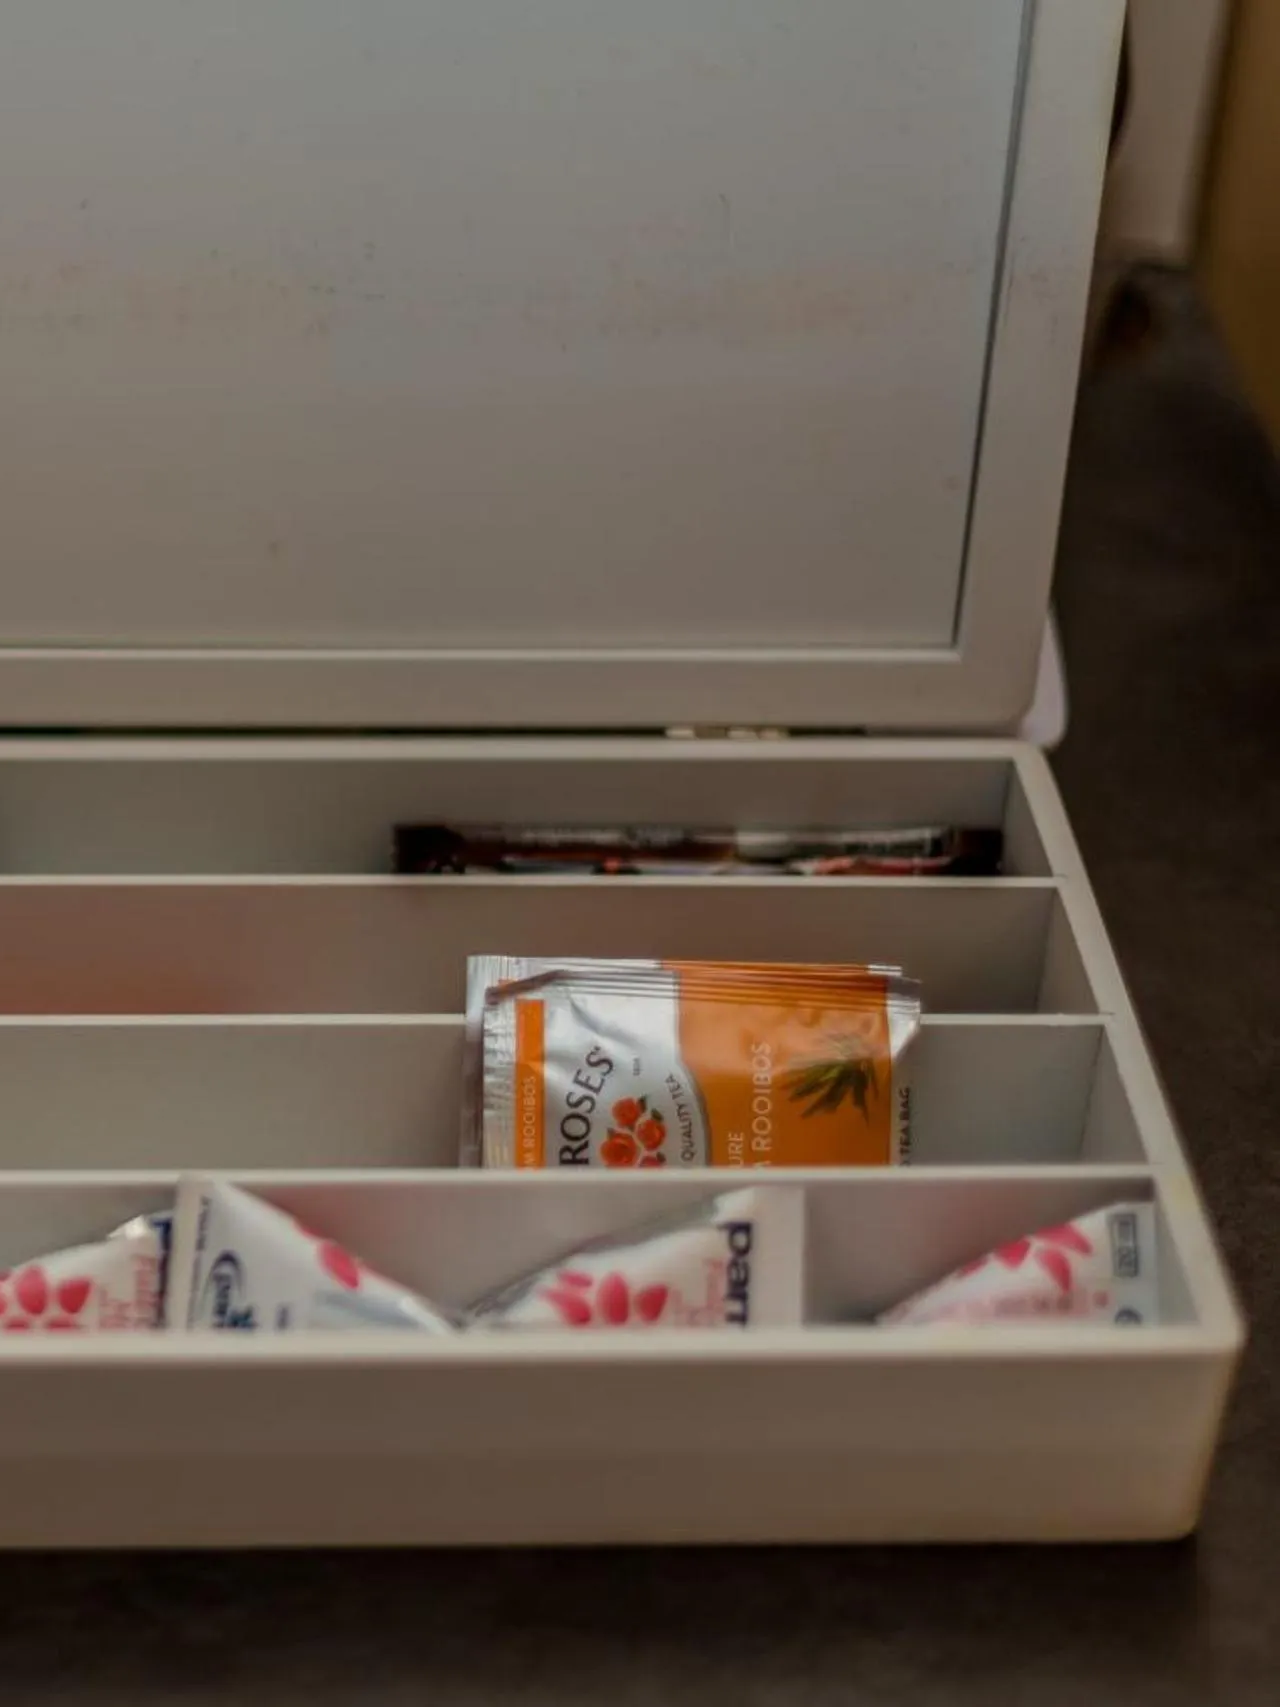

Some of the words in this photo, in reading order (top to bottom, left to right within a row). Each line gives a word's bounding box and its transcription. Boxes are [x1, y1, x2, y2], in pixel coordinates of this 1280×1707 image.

[522, 1075, 536, 1149] ROOIBOS
[559, 1046, 614, 1165] ROSES
[665, 1073, 683, 1100] TEA
[751, 1041, 773, 1152] ROOIBOS
[676, 1103, 696, 1162] QUALITY
